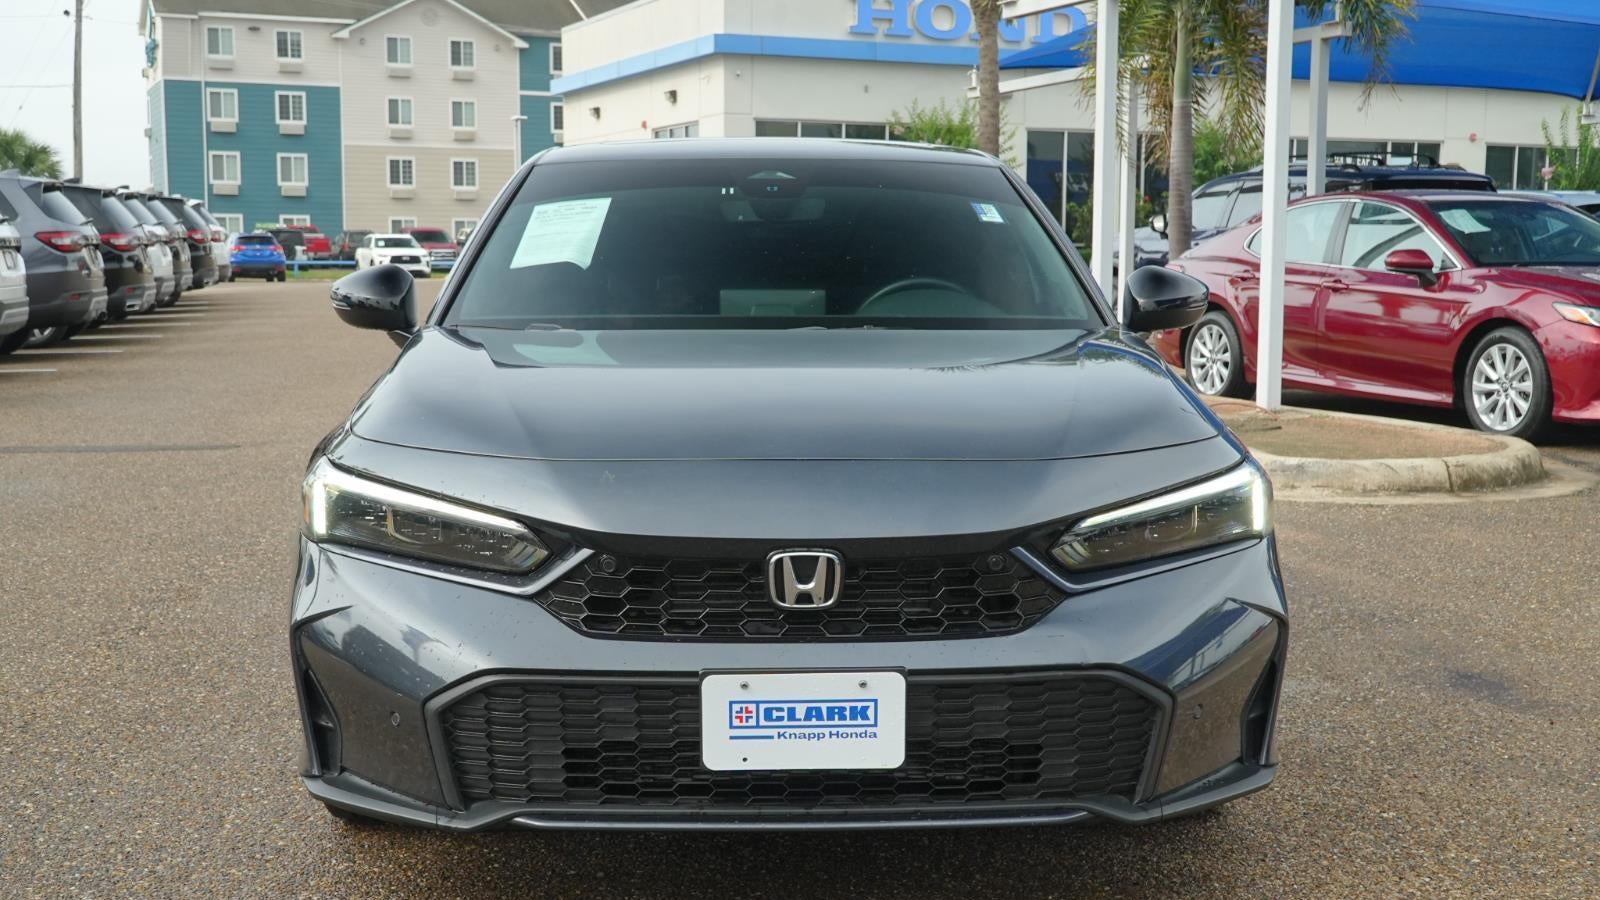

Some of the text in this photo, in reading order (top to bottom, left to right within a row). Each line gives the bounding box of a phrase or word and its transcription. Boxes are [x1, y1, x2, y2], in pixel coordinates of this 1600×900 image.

[848, 0, 1088, 44] HOD
[763, 705, 871, 723] CLARK
[777, 730, 878, 741] Knapp Honda
